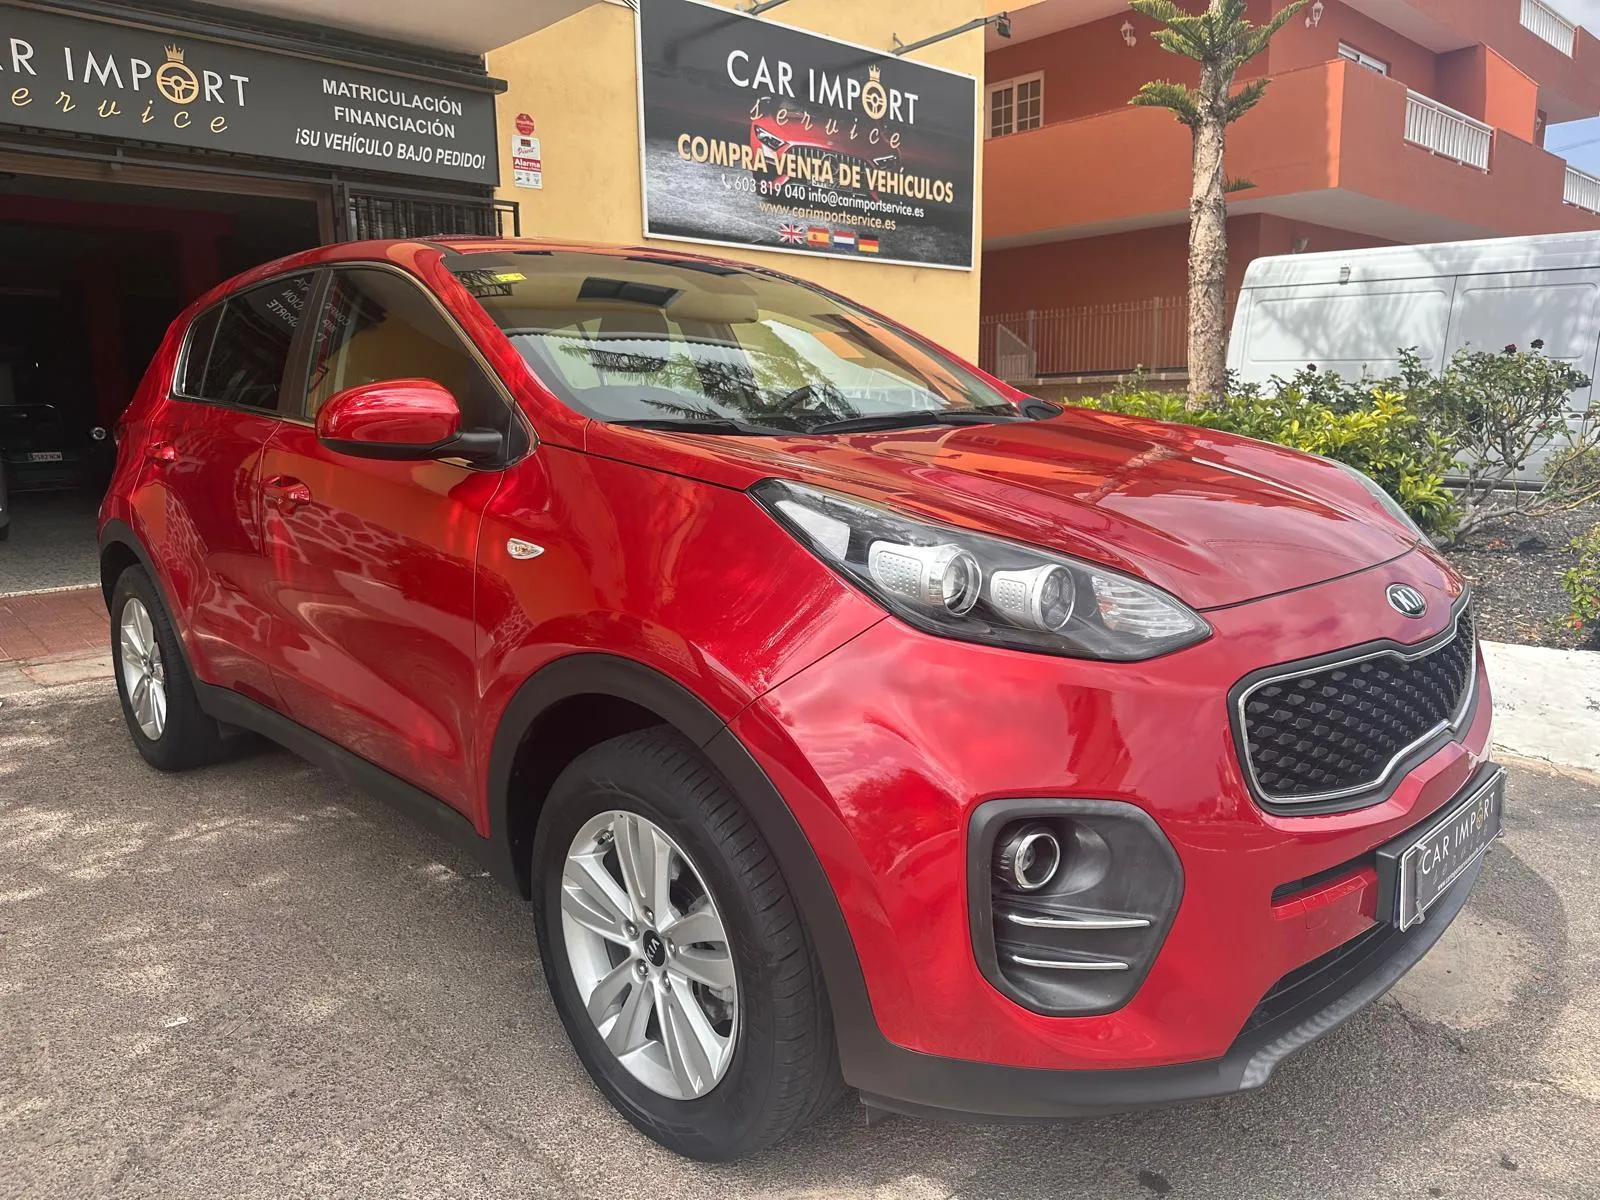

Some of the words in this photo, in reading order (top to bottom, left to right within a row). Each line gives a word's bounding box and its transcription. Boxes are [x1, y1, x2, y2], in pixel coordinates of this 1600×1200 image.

[0, 38, 37, 76] R
[64, 47, 249, 107] IMPORT
[727, 49, 795, 98] CAR
[809, 68, 919, 125] IMPORT
[323, 78, 462, 116] MATRICULACIÓN
[334, 106, 456, 139] FINANCIACIÓN
[295, 128, 321, 147] ¡SU
[324, 132, 393, 157] VEHÍCULO
[397, 143, 433, 163] BAJO
[435, 148, 486, 170] PEDIDO!
[514, 158, 541, 169] Alarma
[677, 133, 768, 173] COMPRA
[774, 152, 834, 184] VENTA
[839, 163, 861, 188] DE
[865, 167, 953, 203] VEHÍCULOS
[734, 176, 757, 193] 603
[760, 180, 781, 197] 819
[784, 184, 806, 200] 040
[808, 188, 925, 218] info@carimportservice.es
[759, 201, 897, 231] www.carimportservice.es
[1422, 836, 1450, 875] CAR
[1455, 792, 1495, 848] IMPORT
[646, 938, 660, 962] KIA
